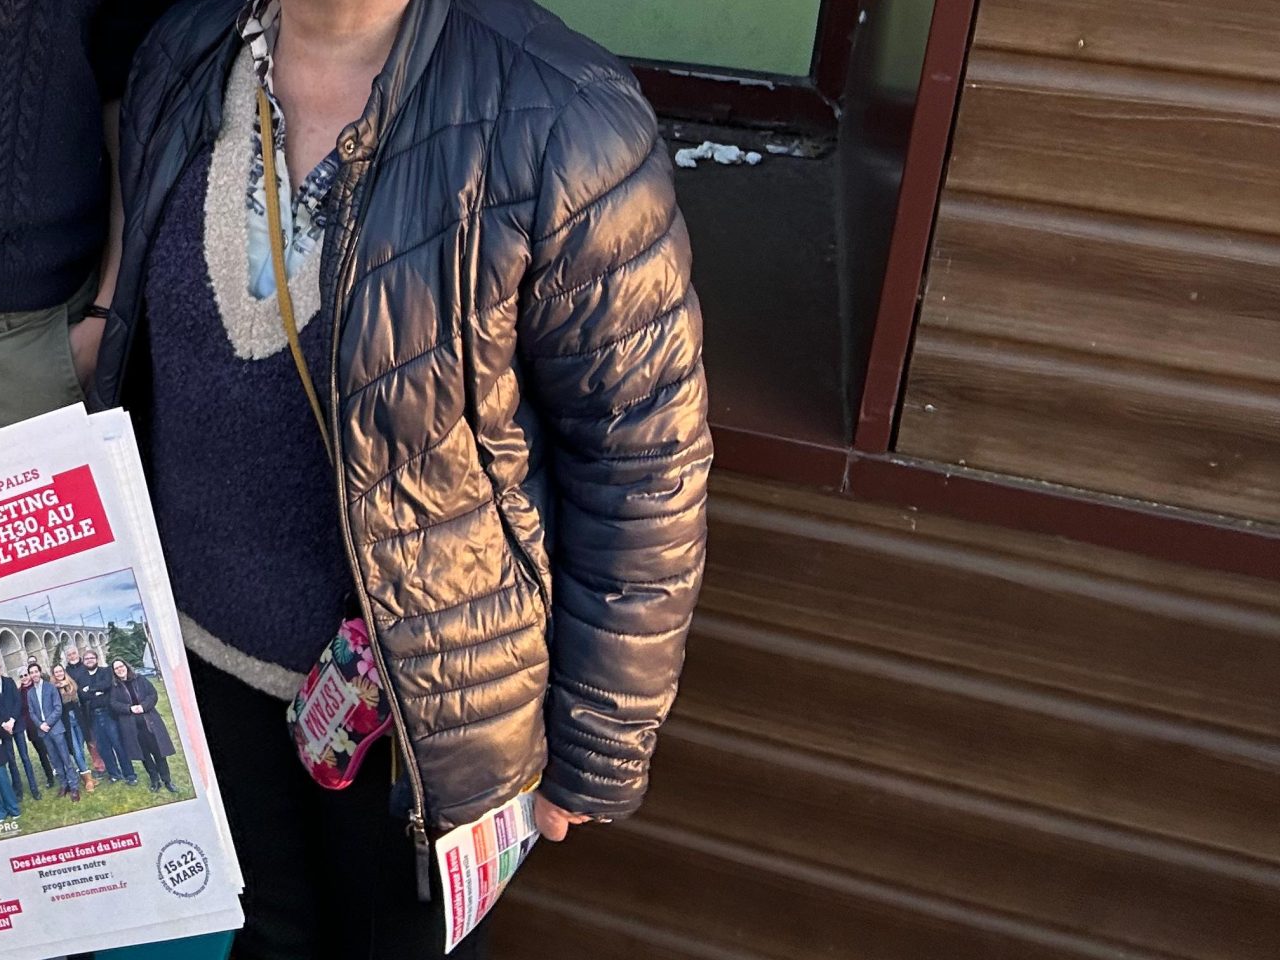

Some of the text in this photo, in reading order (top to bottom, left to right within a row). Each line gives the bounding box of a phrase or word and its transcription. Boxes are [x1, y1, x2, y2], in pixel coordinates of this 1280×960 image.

[48, 504, 74, 527] AU
[12, 860, 30, 869] Des
[32, 854, 58, 866] idées
[58, 851, 75, 862] qui
[75, 846, 96, 858] font
[96, 842, 110, 852] du
[111, 838, 134, 849] bien
[164, 860, 177, 874] 15
[181, 850, 196, 865] 22
[38, 859, 106, 879] Retrouvez notre
[170, 862, 204, 887] MARS
[42, 875, 93, 893] programme
[94, 872, 109, 881] sur
[50, 881, 127, 902] avonencommun.fr
